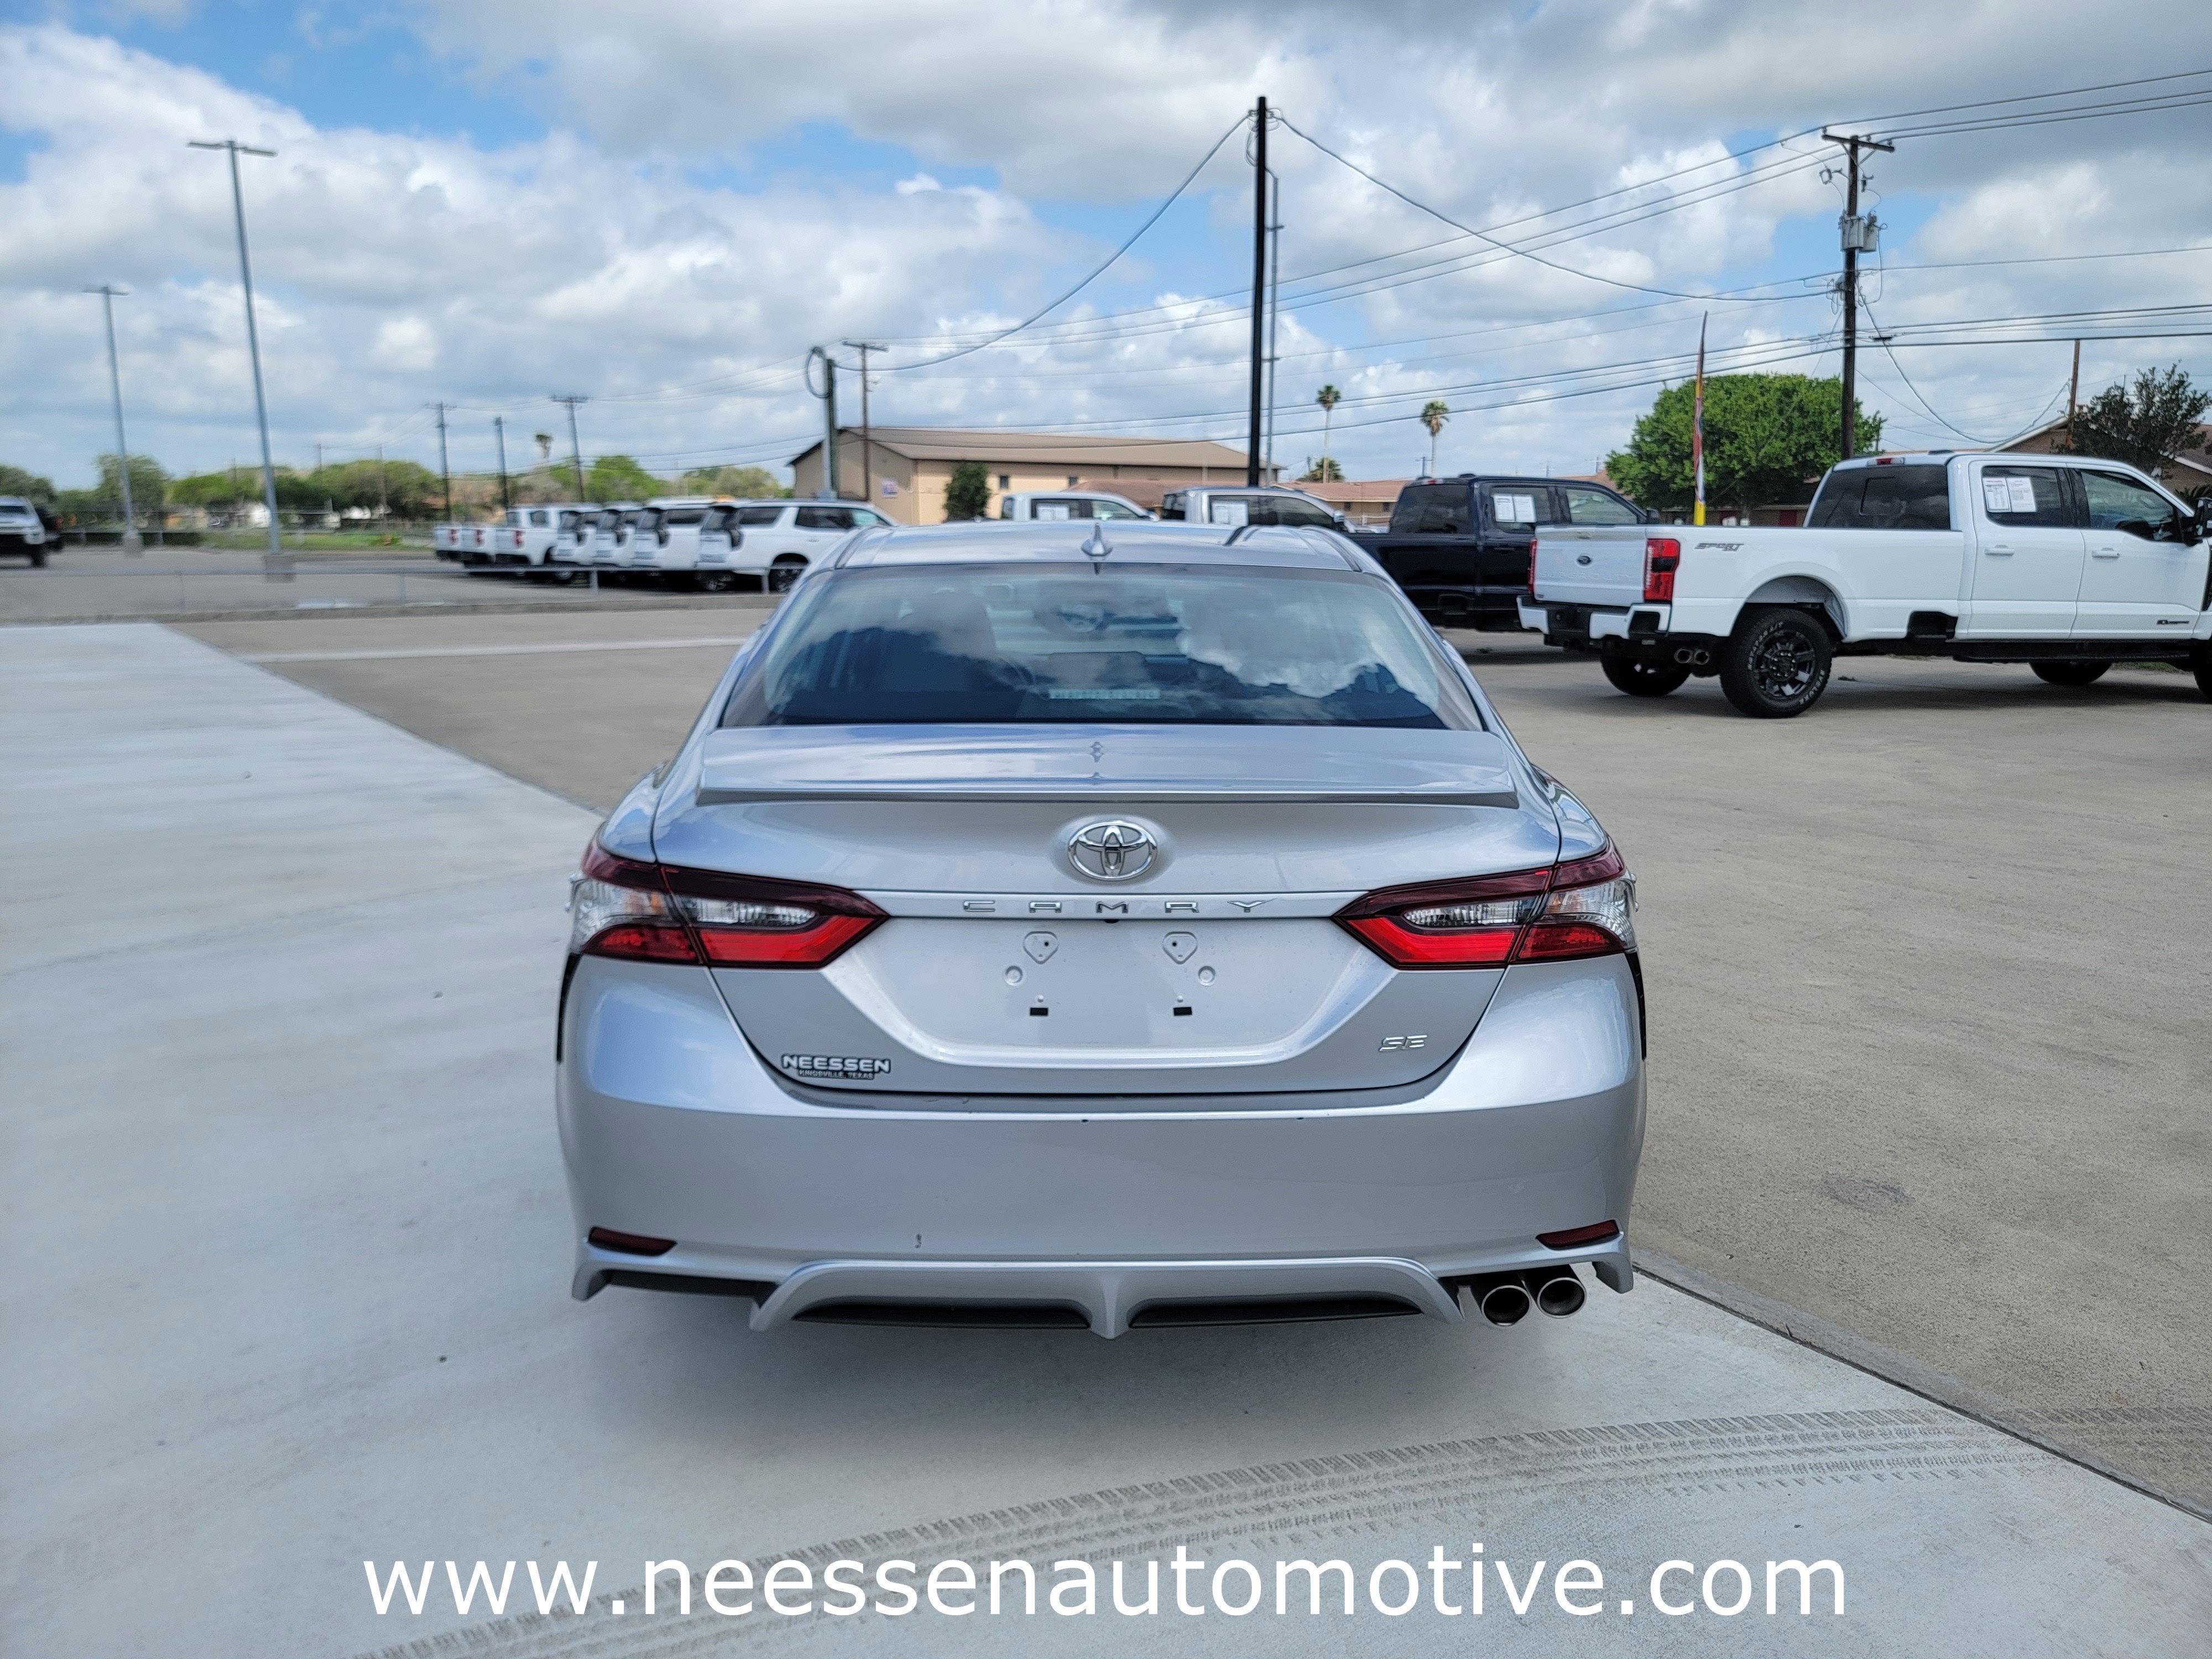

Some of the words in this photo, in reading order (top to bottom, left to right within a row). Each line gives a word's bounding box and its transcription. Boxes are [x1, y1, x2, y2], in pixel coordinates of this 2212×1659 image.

[962, 897, 1277, 914] CAMRY
[1378, 1034, 1428, 1052] SE
[781, 1055, 890, 1072] NEESSEN
